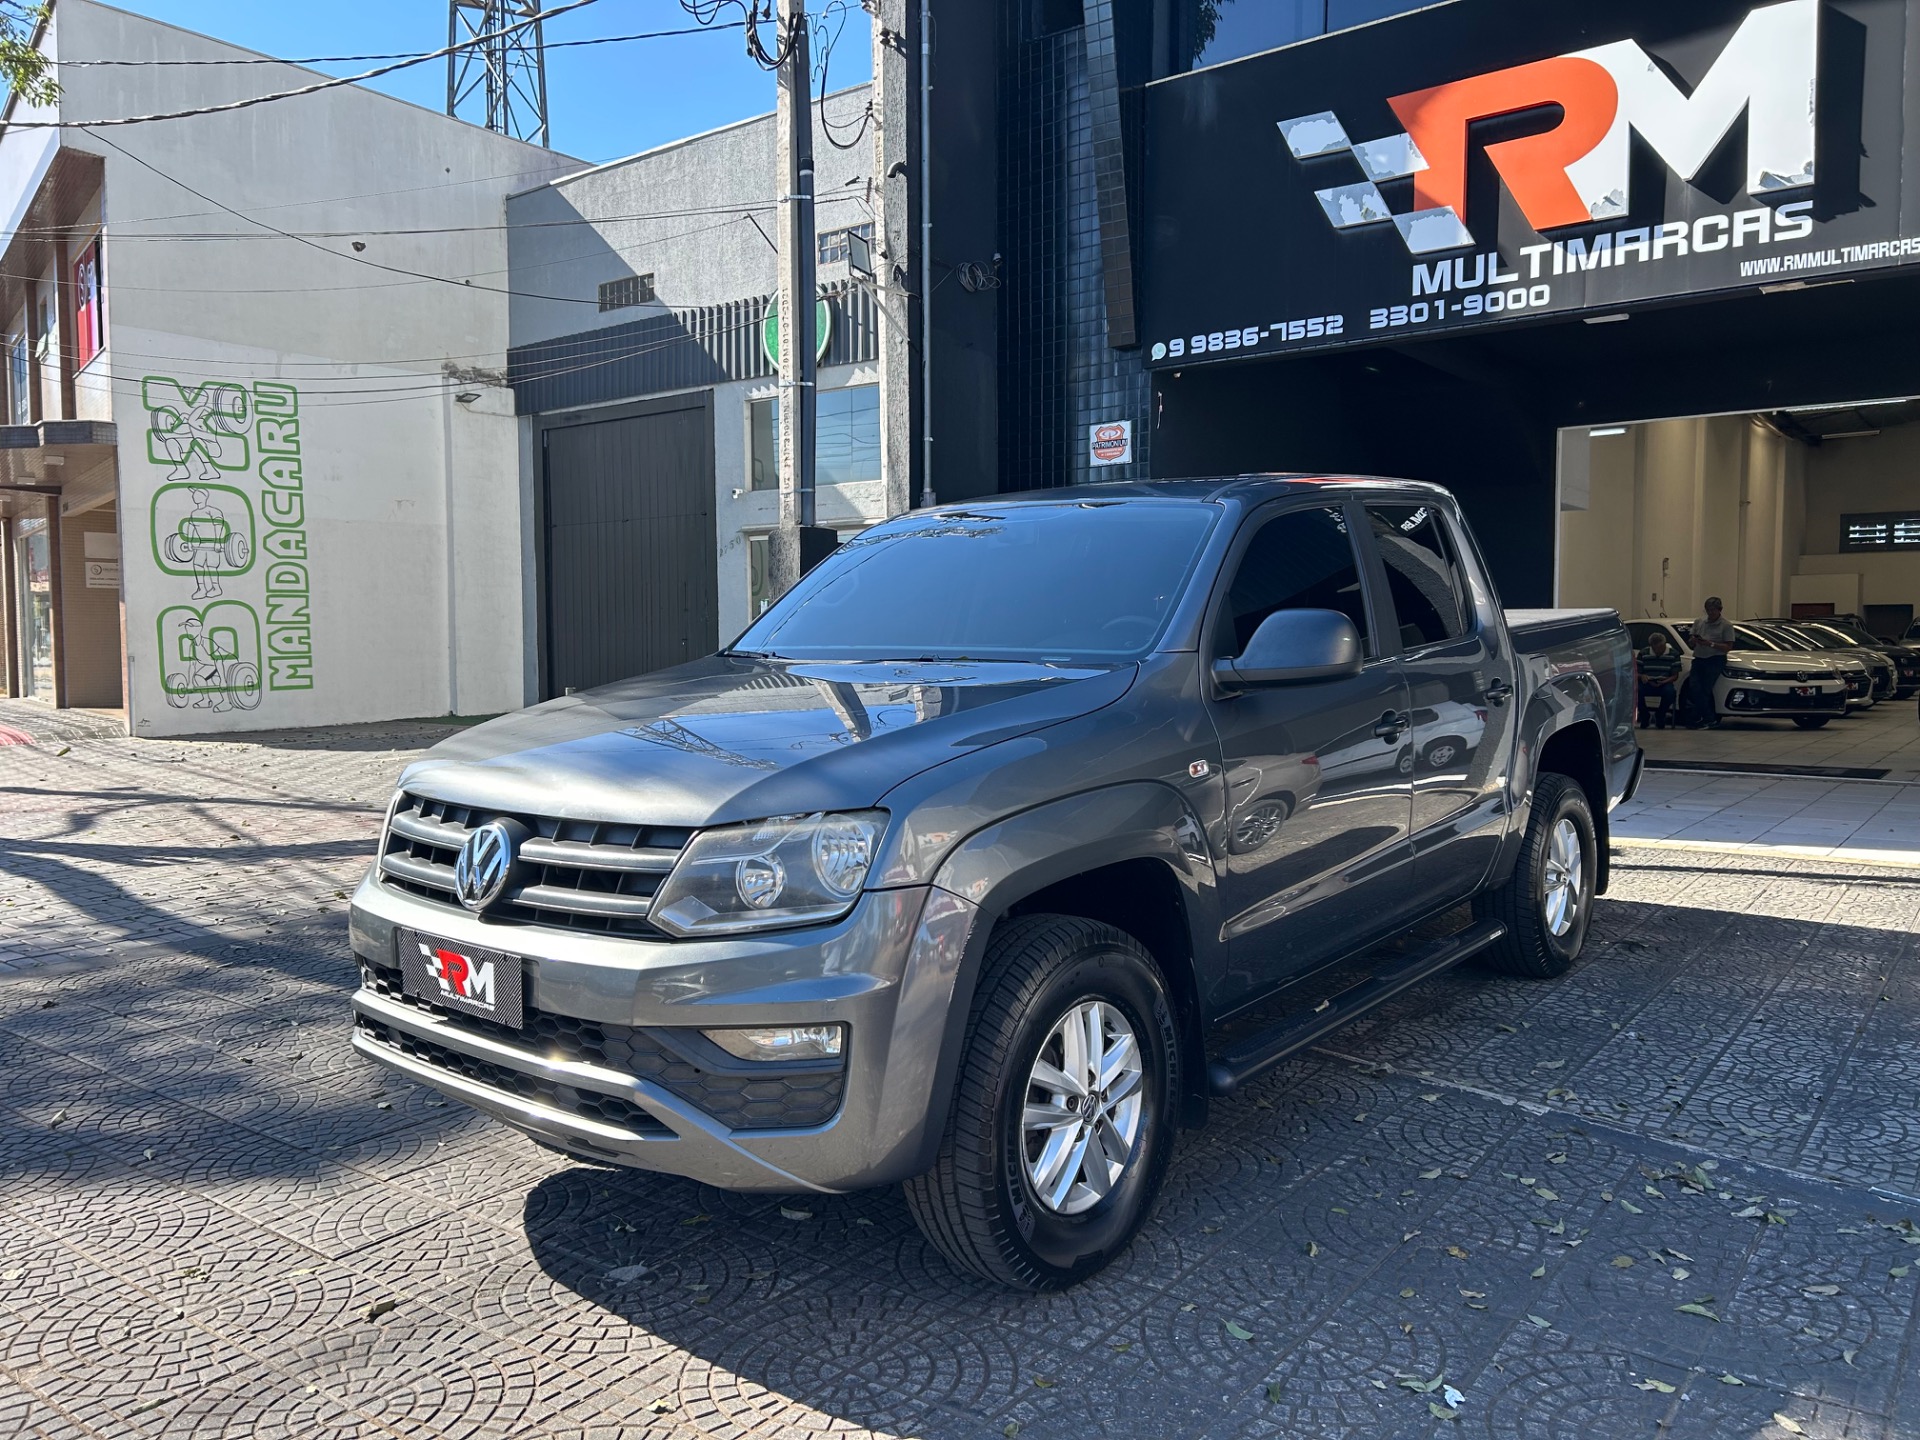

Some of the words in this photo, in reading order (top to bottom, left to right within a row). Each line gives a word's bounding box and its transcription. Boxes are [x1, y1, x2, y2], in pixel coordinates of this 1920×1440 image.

[1386, 0, 1818, 231] RM
[1412, 200, 1814, 296] MULTIMARCAS
[1168, 338, 1185, 358] 9
[1190, 314, 1344, 355] 9836-7552
[1369, 284, 1551, 330] 3301-9000
[142, 376, 262, 694] BOX
[253, 380, 314, 692] MANDACARU
[435, 948, 495, 1005] RM
